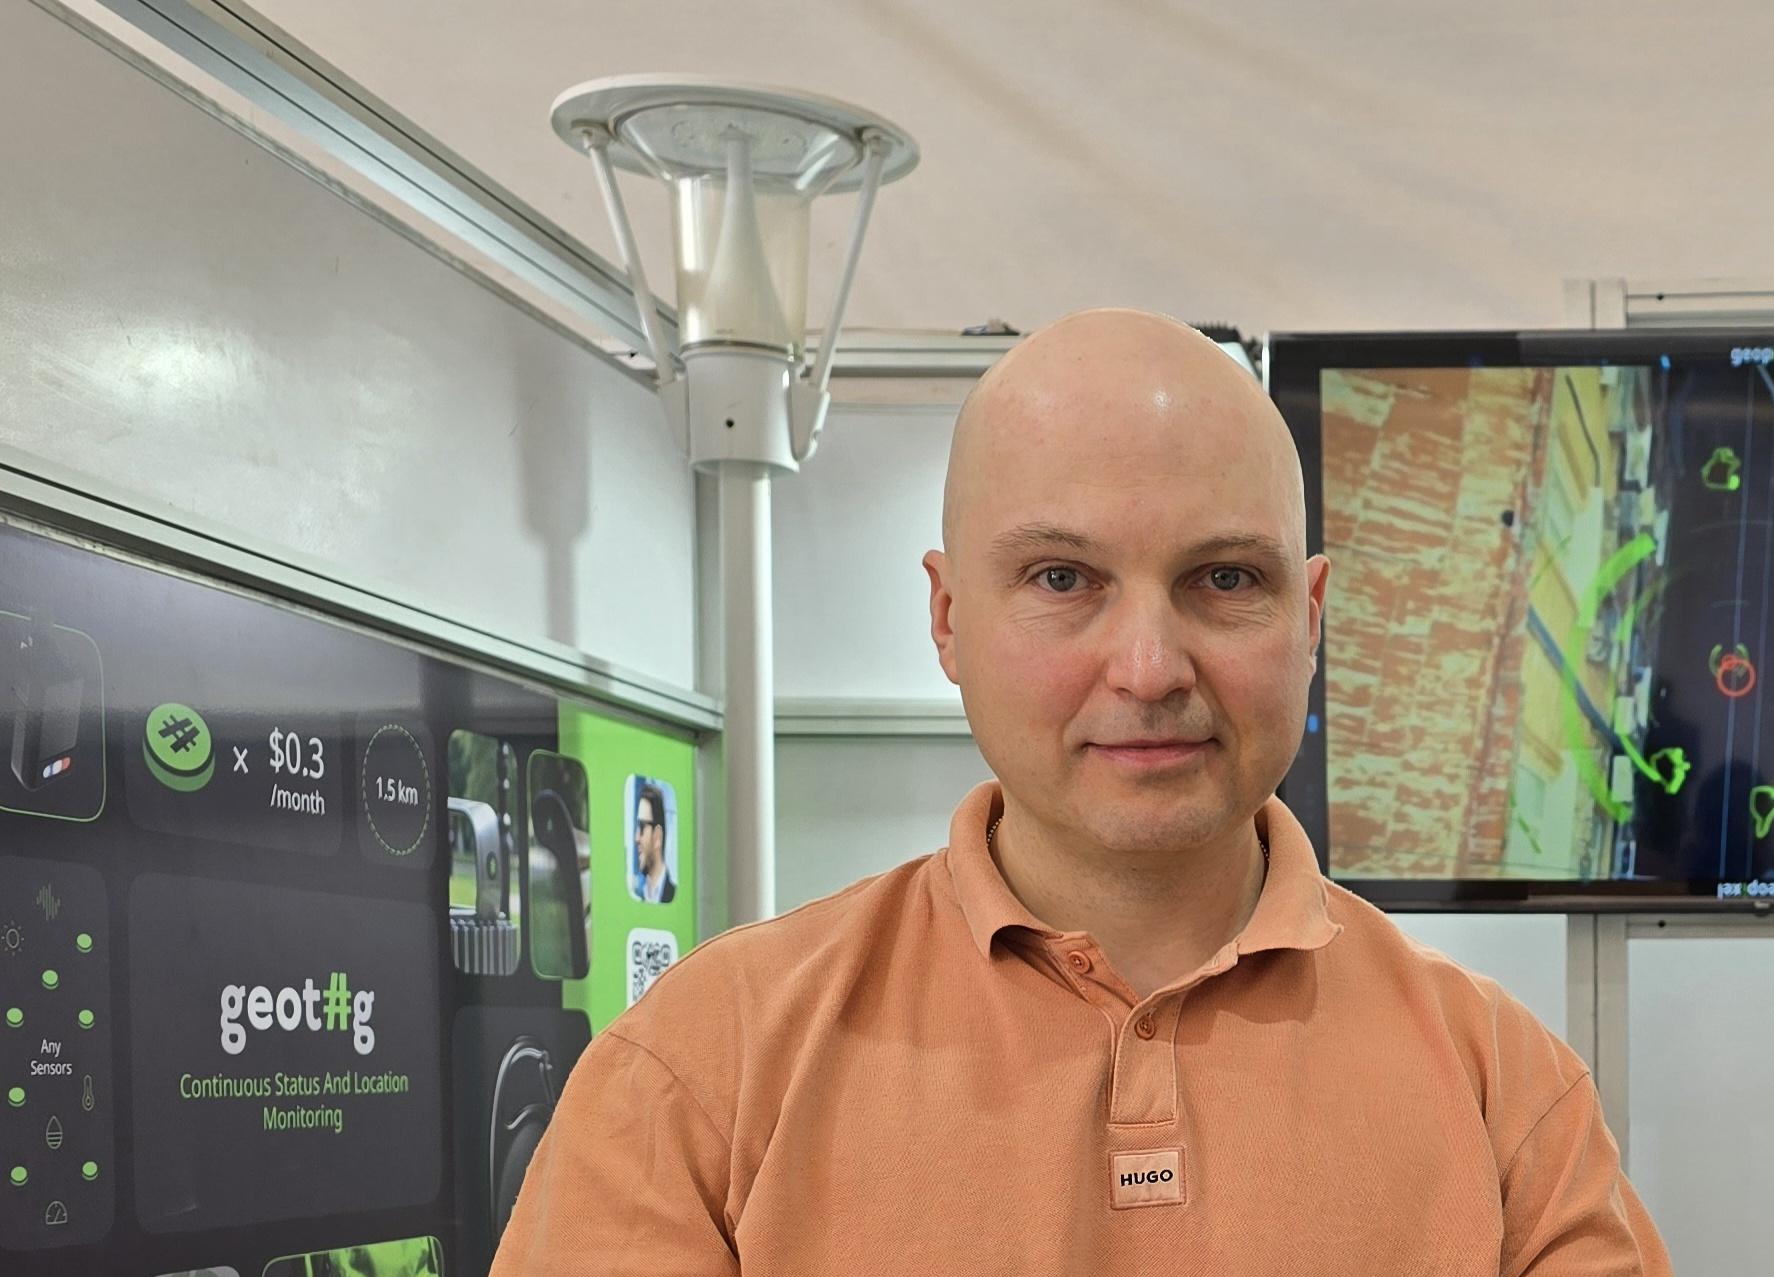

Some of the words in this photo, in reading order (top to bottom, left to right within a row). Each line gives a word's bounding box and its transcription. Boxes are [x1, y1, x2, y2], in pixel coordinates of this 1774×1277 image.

[269, 726, 325, 780] $0.3
[270, 783, 326, 816] /month
[376, 775, 396, 802] 1.5
[398, 778, 419, 806] km
[40, 1038, 62, 1058] Any
[30, 1060, 73, 1076] Sensors
[179, 1073, 272, 1099] Continuous
[274, 1071, 321, 1096] Status
[322, 1069, 351, 1095] And
[354, 1070, 409, 1094] Location
[263, 1104, 343, 1134] Monitoring
[1120, 1169, 1174, 1187] HUGO
